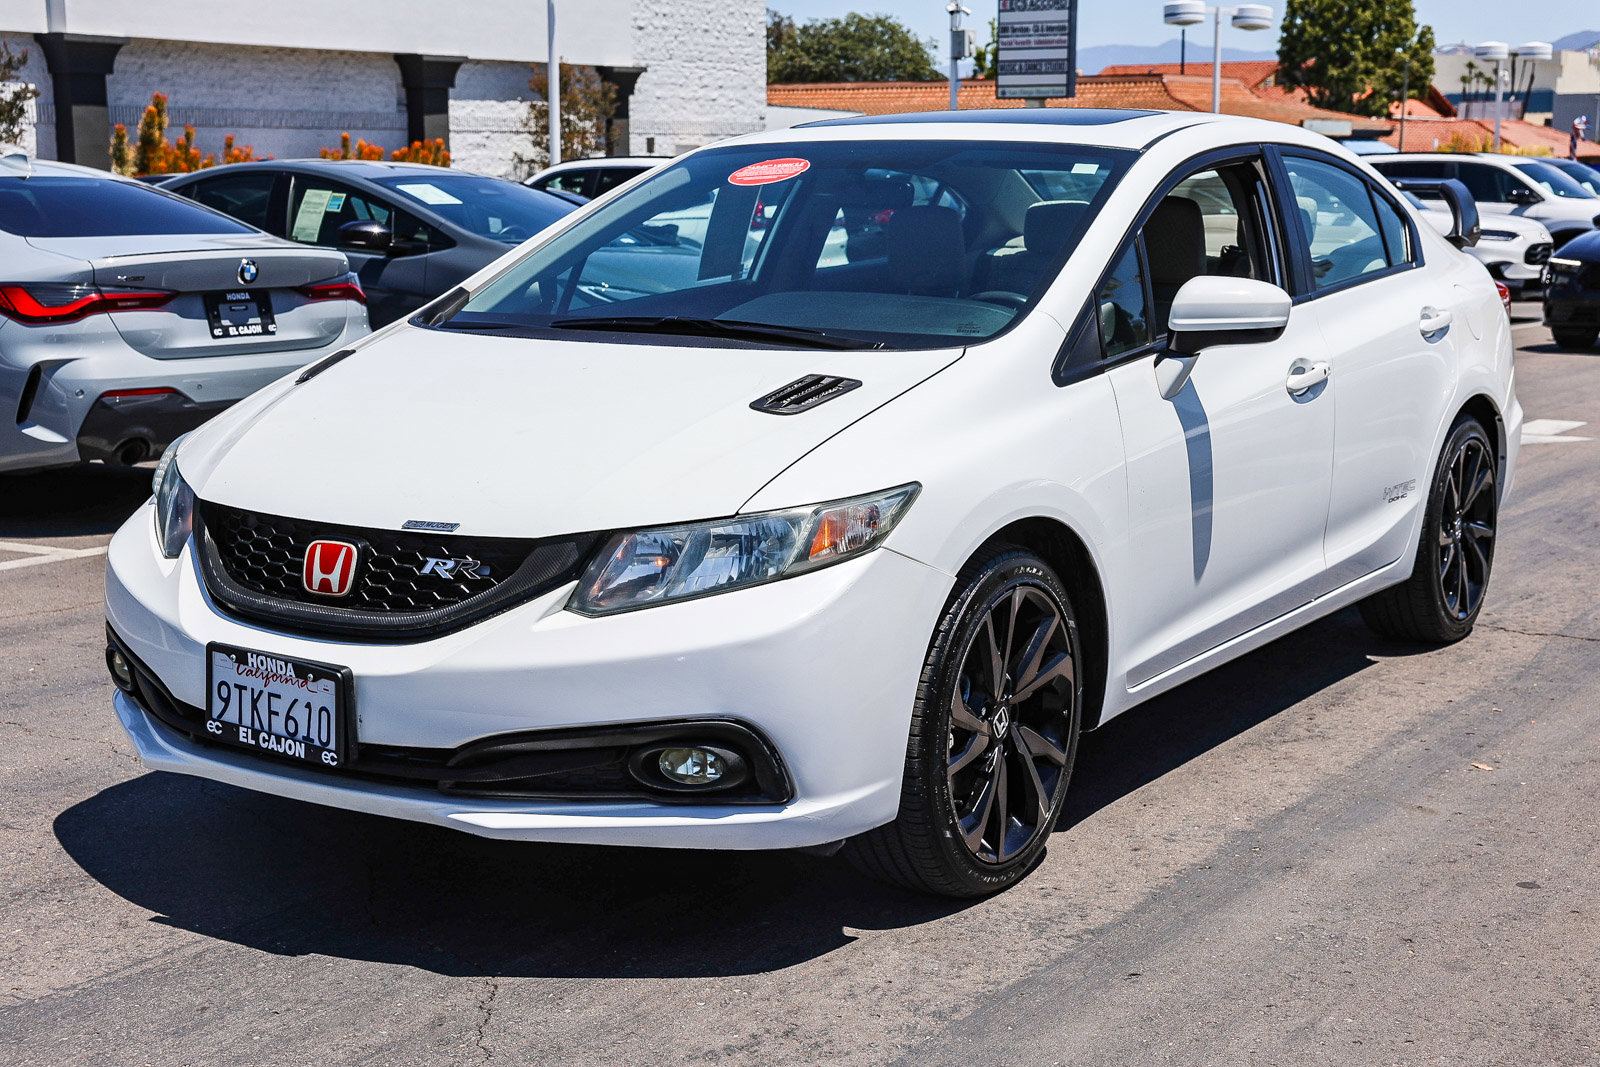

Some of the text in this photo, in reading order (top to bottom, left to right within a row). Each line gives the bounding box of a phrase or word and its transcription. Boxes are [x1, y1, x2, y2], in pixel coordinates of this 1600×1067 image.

[226, 292, 251, 300] HONDA
[229, 325, 262, 335] EL CAJON
[1388, 493, 1407, 503] DOHC
[247, 652, 296, 678] HONDA
[236, 663, 318, 694] California
[216, 680, 331, 748] 9TKF610
[239, 726, 306, 759] EL CAJON
